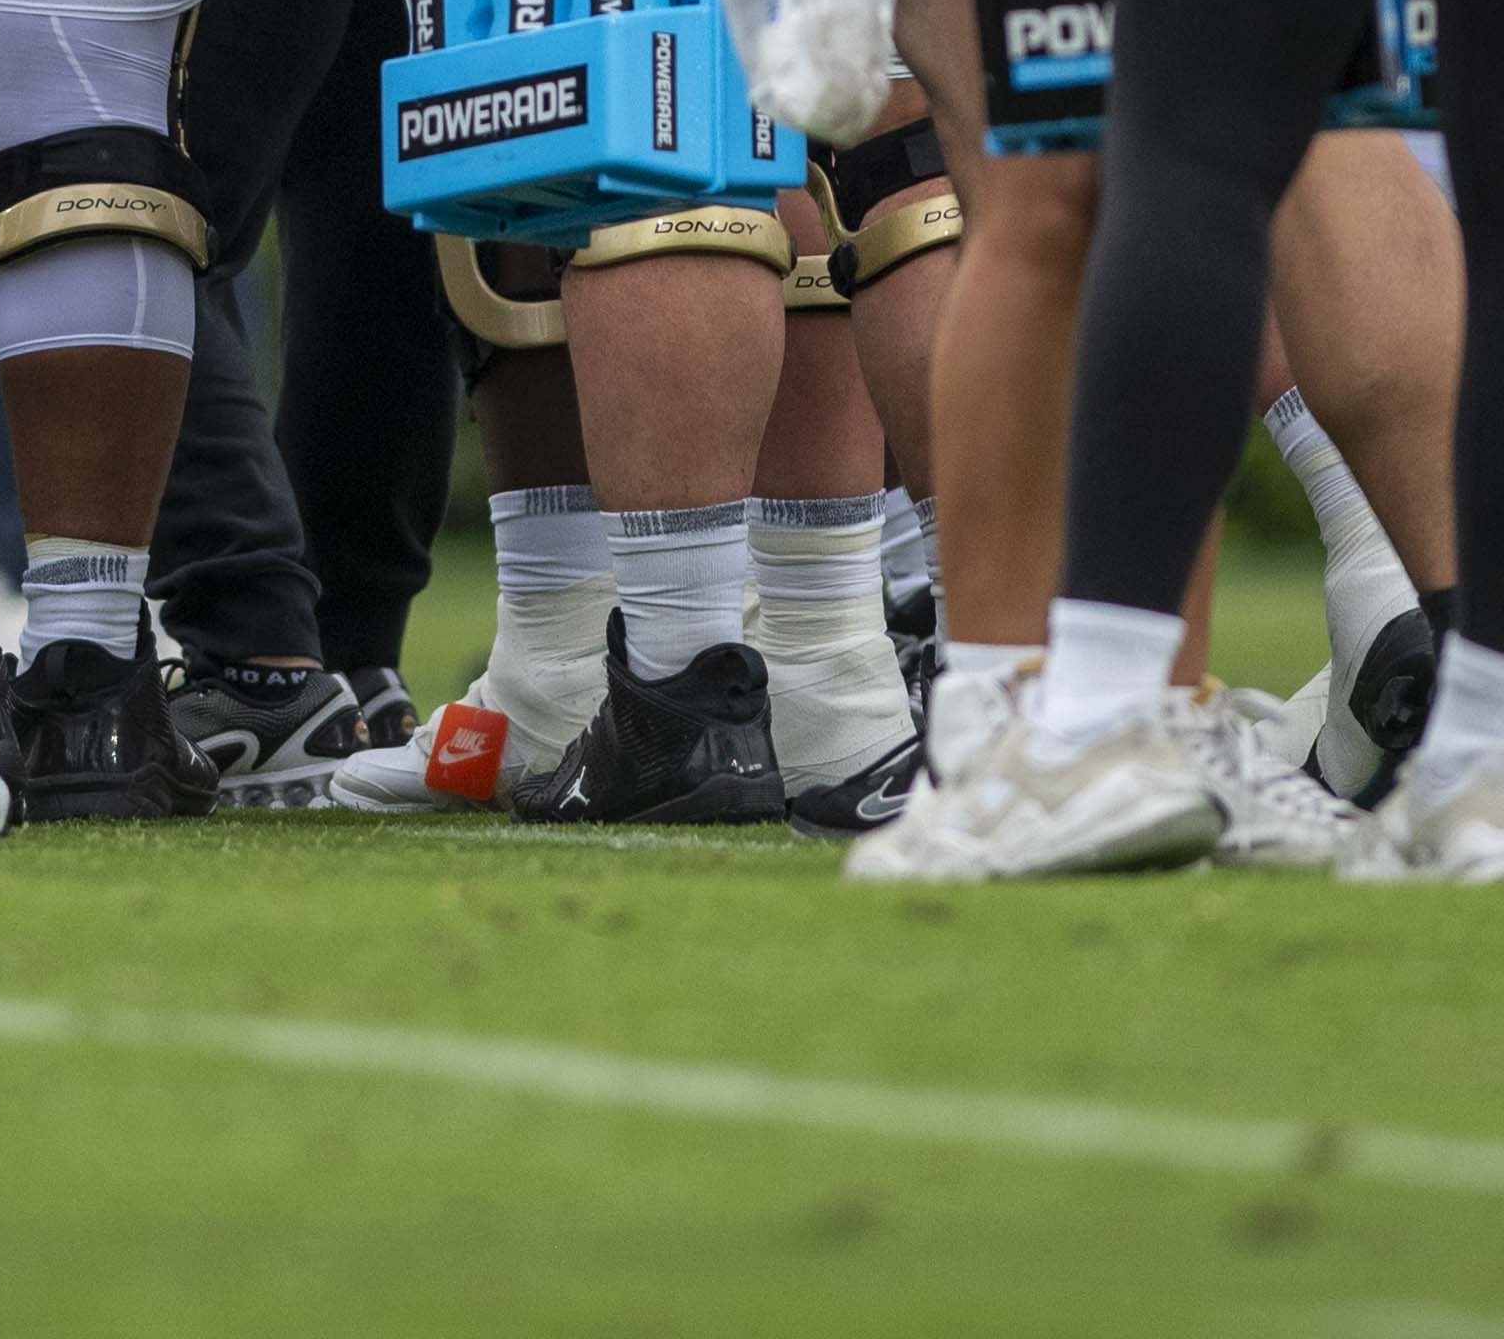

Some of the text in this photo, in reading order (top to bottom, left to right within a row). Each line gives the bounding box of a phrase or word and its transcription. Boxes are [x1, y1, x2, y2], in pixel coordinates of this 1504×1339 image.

[401, 76, 582, 152] POWERADE
[655, 32, 674, 150] POWERADE
[55, 195, 167, 217] DONJOY
[654, 220, 760, 235] DONJOY
